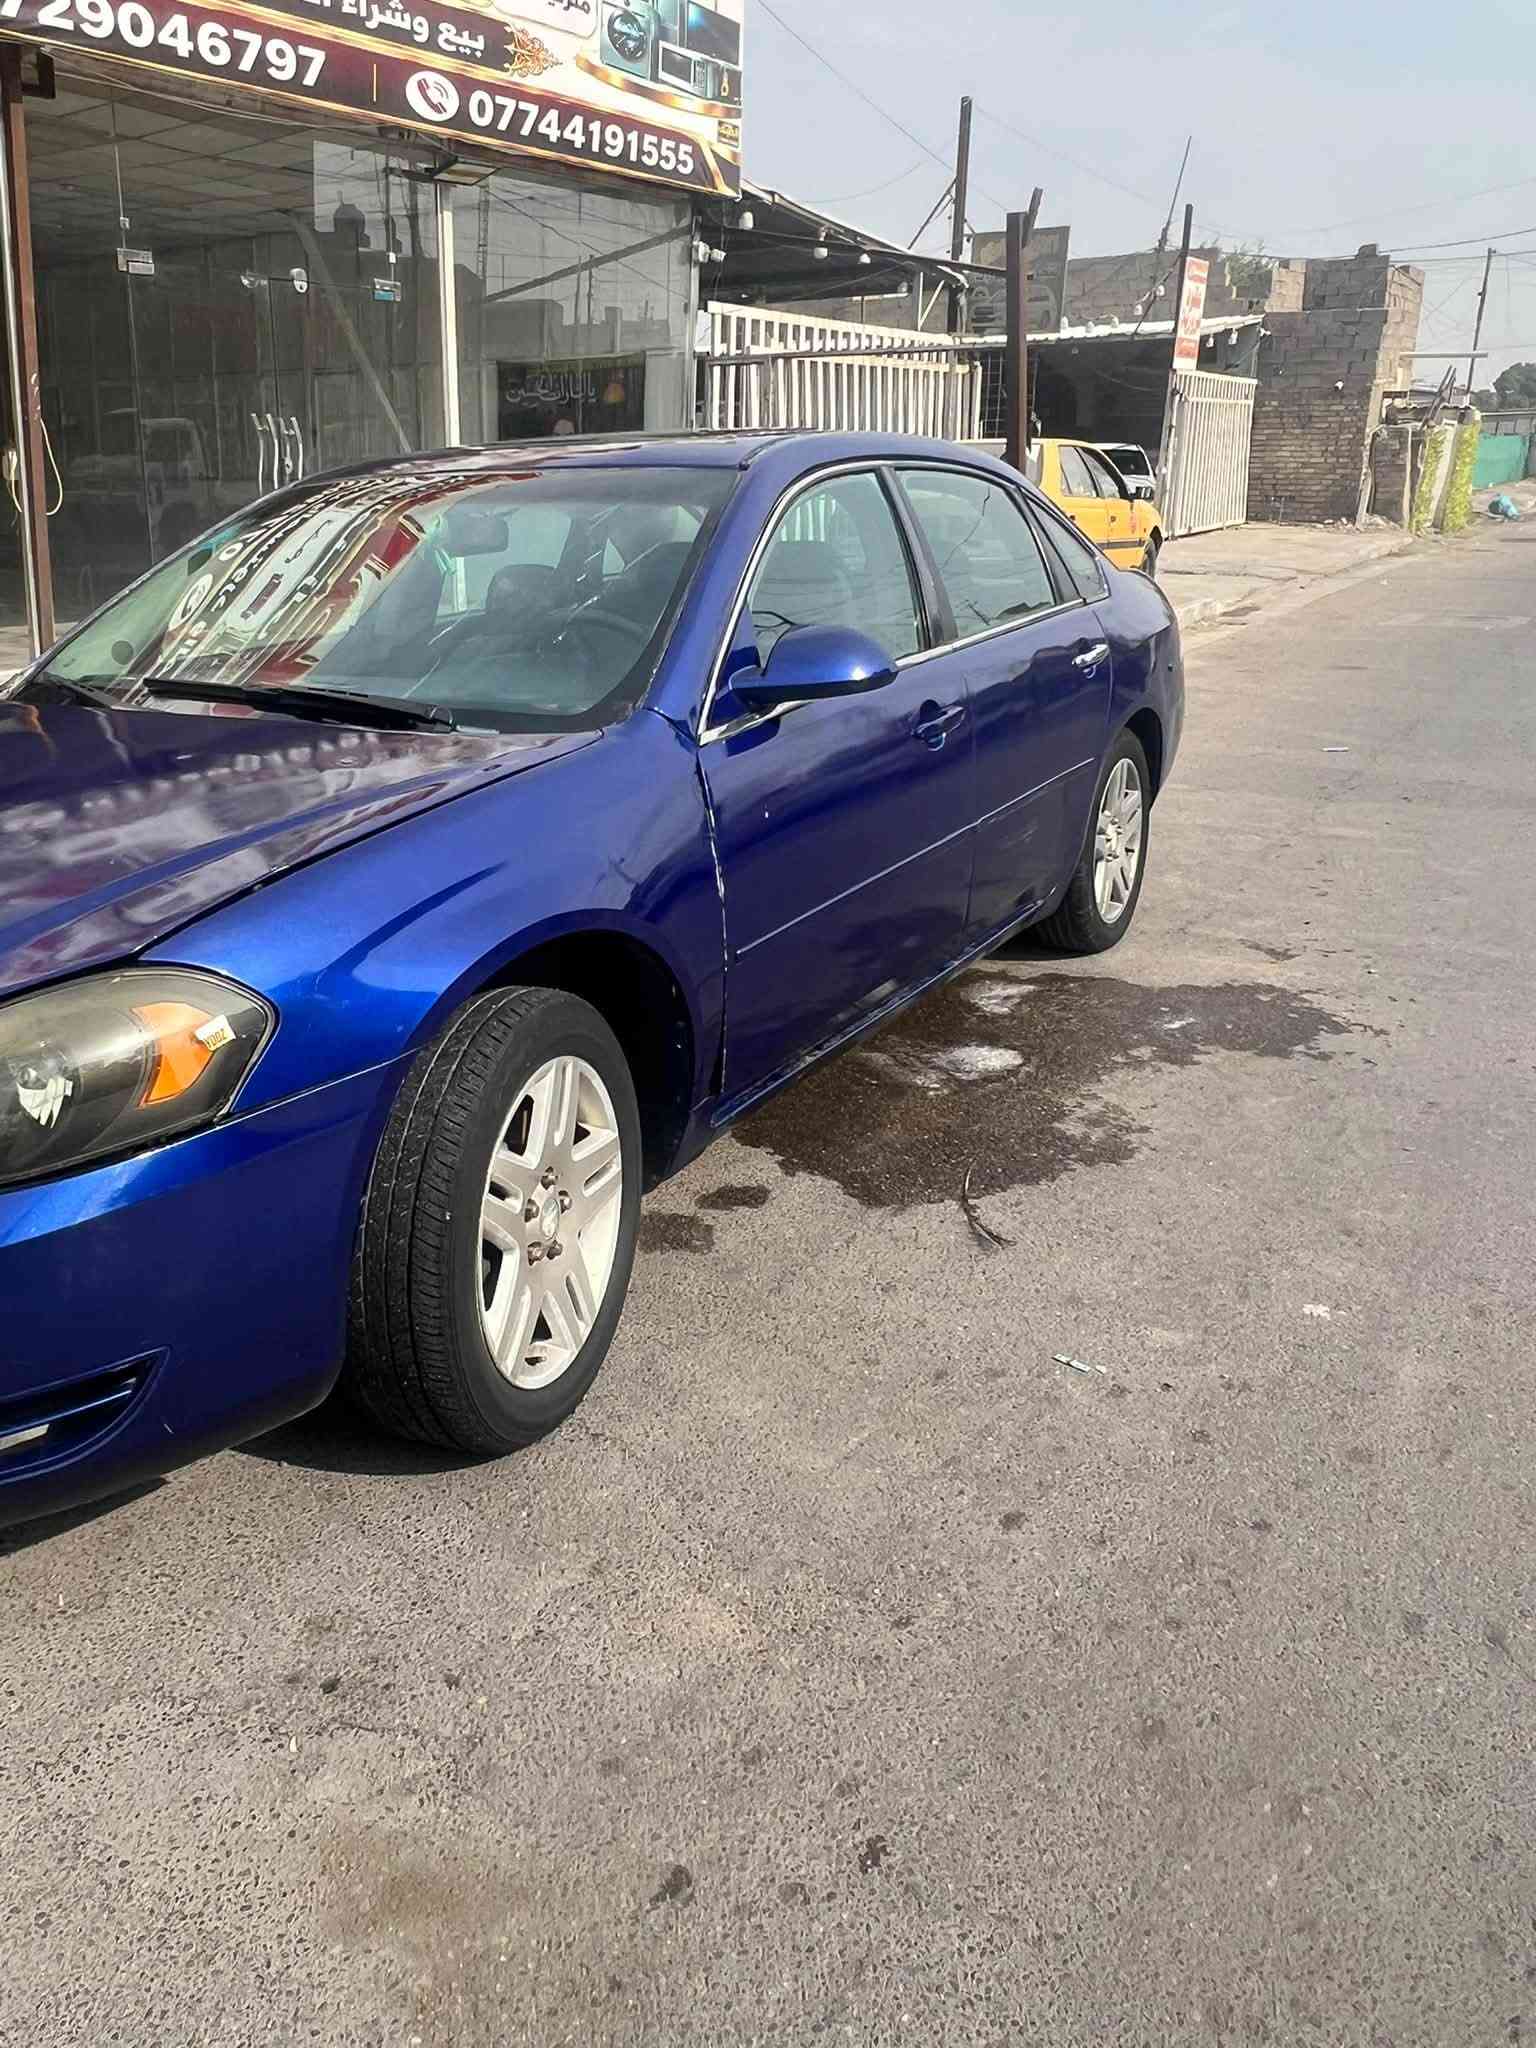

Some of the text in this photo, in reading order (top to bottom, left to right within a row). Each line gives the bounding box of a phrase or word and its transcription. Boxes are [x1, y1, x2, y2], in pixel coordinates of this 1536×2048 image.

[341, 0, 485, 58] بيع وشراء
[468, 90, 695, 174] 07744191555
